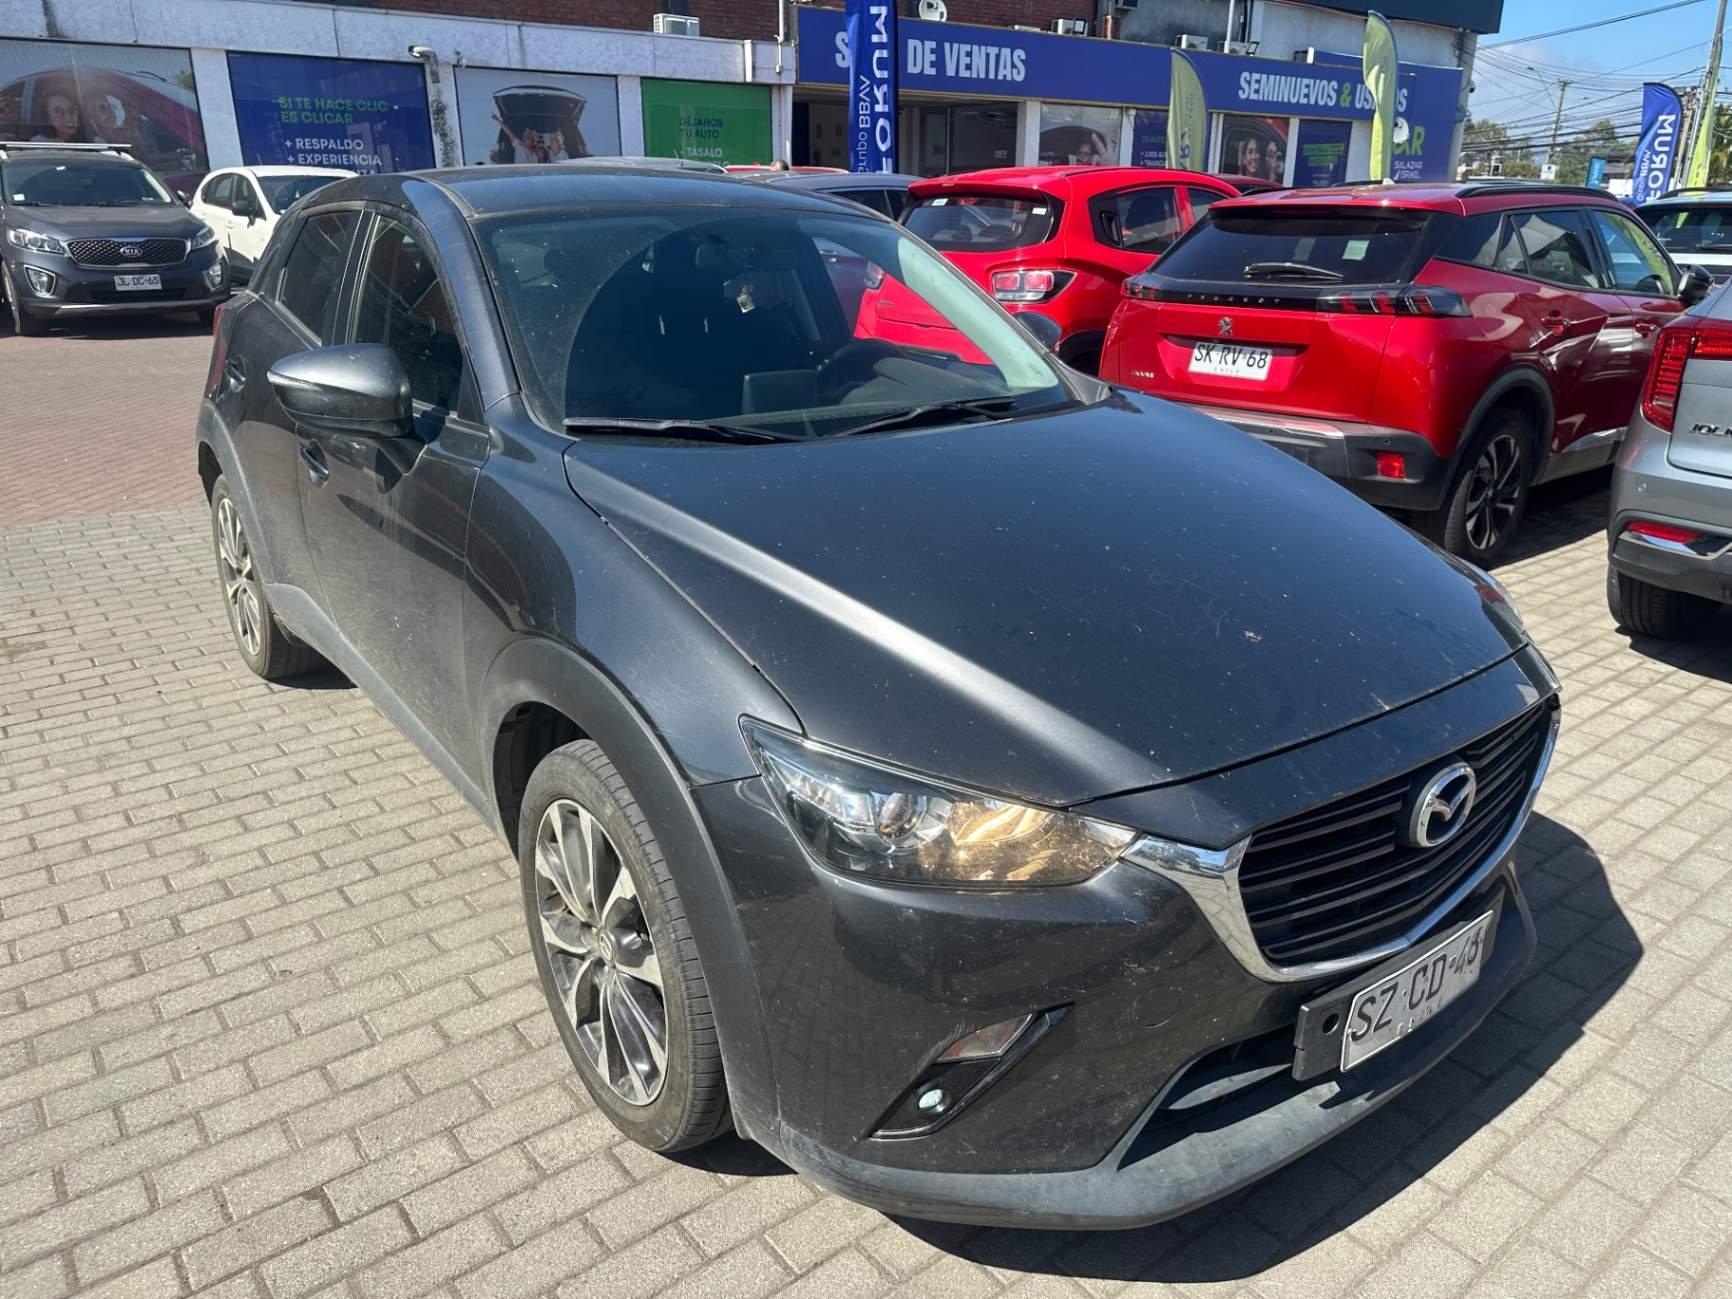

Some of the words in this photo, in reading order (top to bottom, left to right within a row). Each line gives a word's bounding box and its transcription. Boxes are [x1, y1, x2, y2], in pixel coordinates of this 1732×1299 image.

[907, 38, 937, 75] DE
[944, 42, 1027, 82] VENTAS
[1238, 71, 1338, 107] SEMINUEVOS
[1340, 83, 1352, 107] &
[278, 97, 292, 109] SI
[295, 98, 312, 110] TE
[316, 99, 353, 111] HACE
[356, 100, 389, 113] CLIC
[282, 112, 298, 123] ES
[302, 113, 353, 125] CLICAR
[695, 129, 720, 139] AUTO
[296, 138, 364, 151] RESPALDO
[298, 154, 382, 166] EXPERIENCIA
